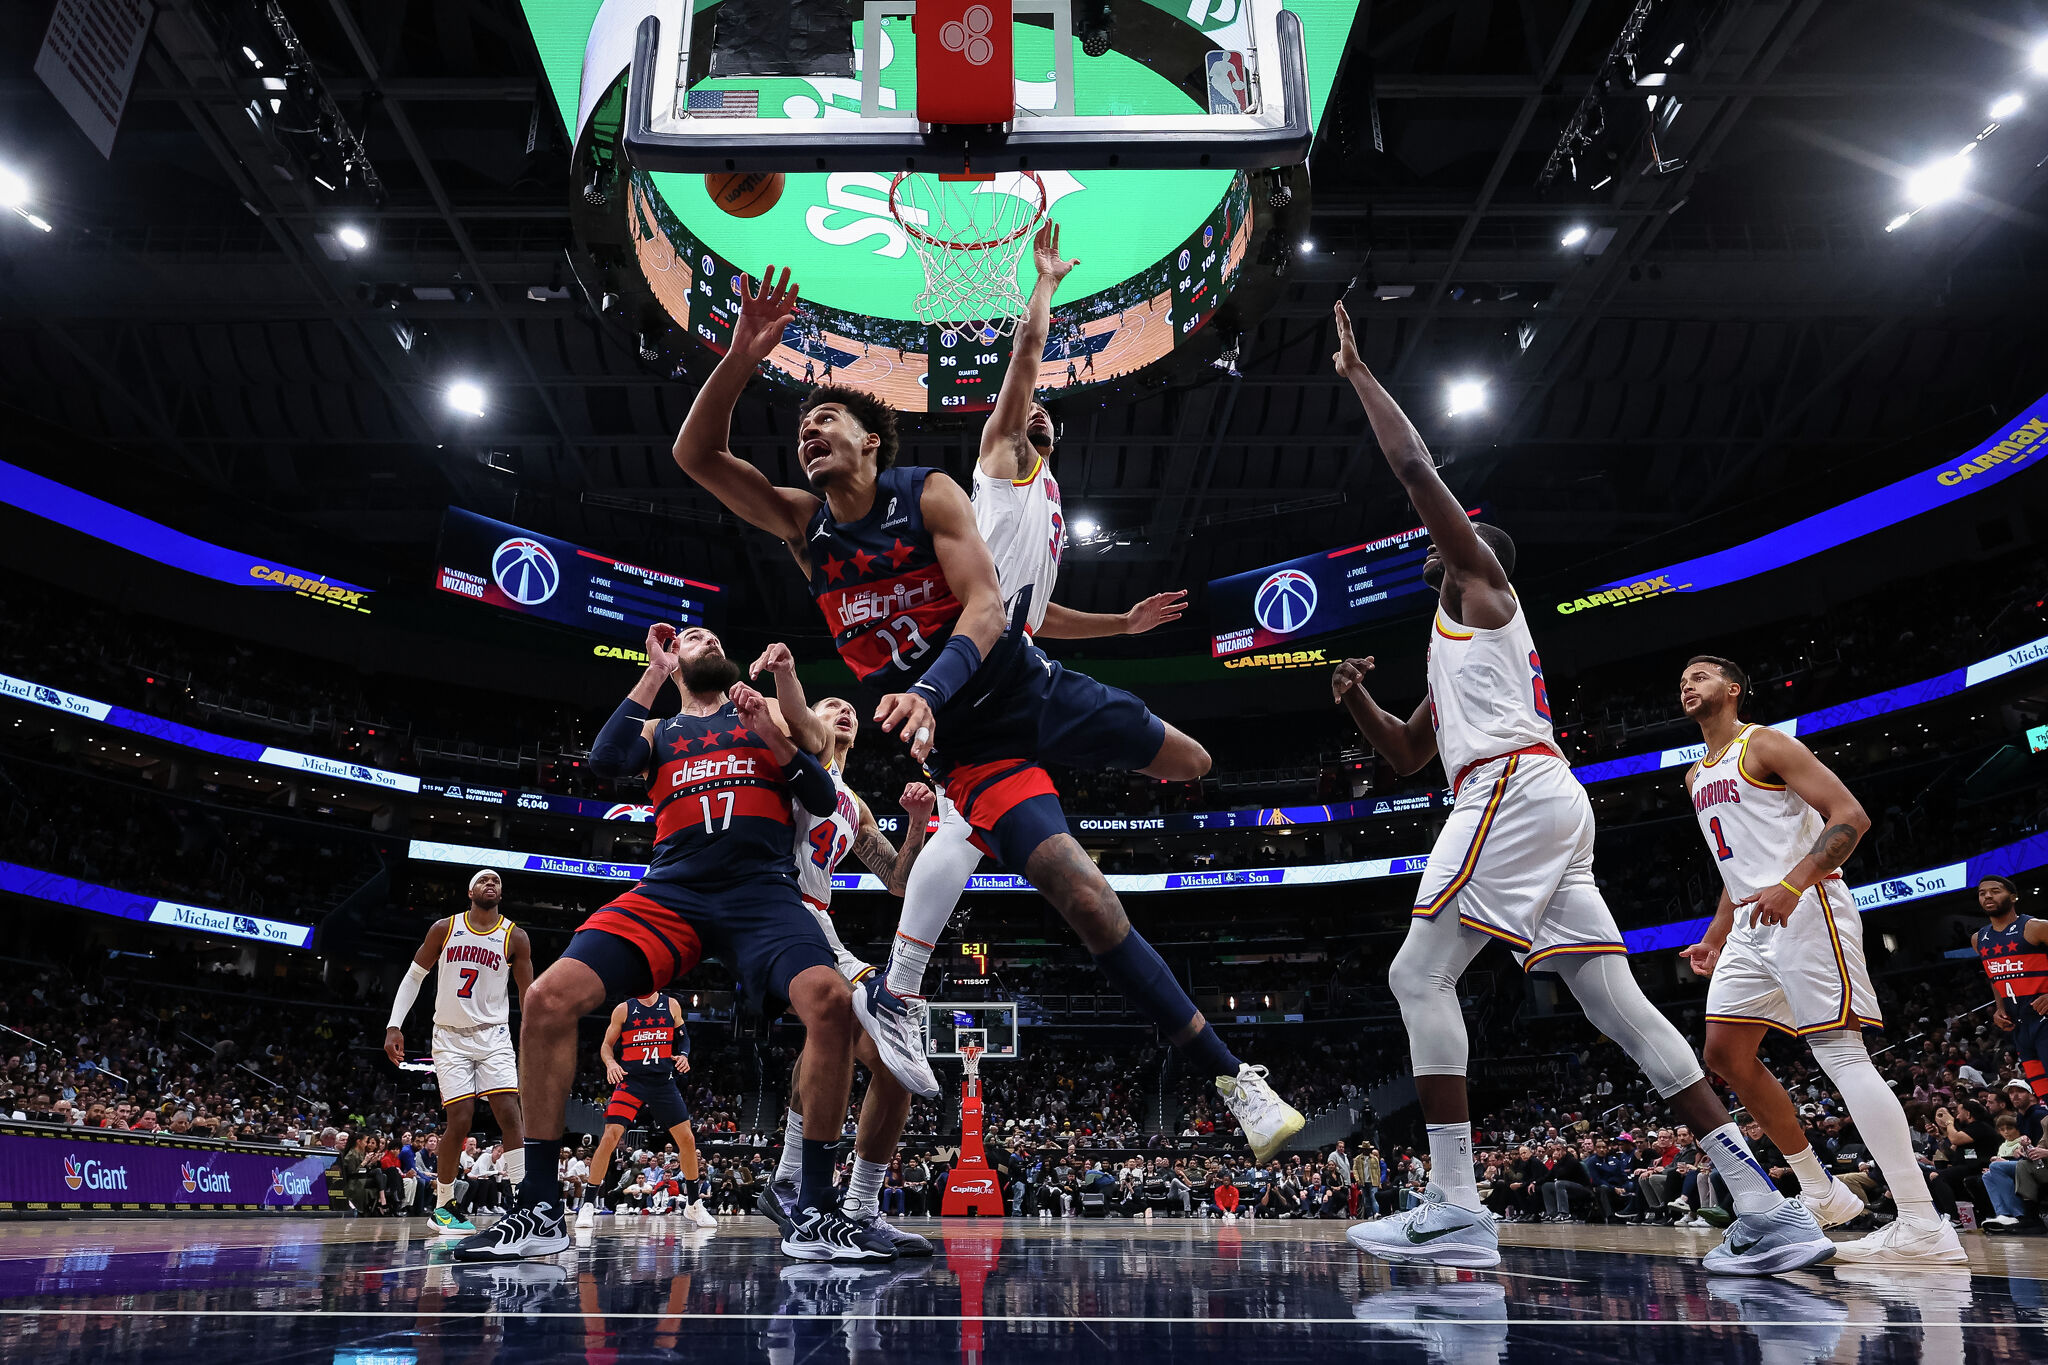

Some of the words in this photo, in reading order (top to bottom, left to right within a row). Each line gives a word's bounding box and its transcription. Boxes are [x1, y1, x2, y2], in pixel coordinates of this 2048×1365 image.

[1201, 250, 1217, 273] 106
[700, 280, 713, 298] 96
[1179, 275, 1192, 293] 96
[1182, 312, 1200, 334] 6:31
[698, 323, 717, 344] 6:31
[940, 356, 957, 367] 96
[974, 353, 999, 366] 106
[942, 396, 966, 406] 6:31
[986, 394, 998, 403] :7
[880, 516, 908, 531] Robinhood
[1366, 536, 1402, 554] SCORING
[1400, 526, 1430, 543] LEAD
[444, 566, 488, 586] WASHINGTON
[614, 562, 649, 579] SCORING
[648, 571, 685, 588] LEADERS
[1352, 566, 1368, 577] POOLE
[250, 566, 364, 605] CARmax
[442, 576, 485, 599] WIZARDS
[1354, 580, 1374, 592] GEORGE
[838, 580, 935, 627] district
[854, 590, 871, 601] THE
[1356, 591, 1388, 606] CARRINGTON
[1556, 576, 1672, 615] CARmax
[876, 616, 931, 672] 13
[1216, 627, 1255, 642] WASHINGTON
[1216, 636, 1254, 655] WIZARDS
[2008, 644, 2048, 668] Micha
[65, 697, 90, 715] Son
[302, 758, 348, 776] Michael
[376, 773, 397, 786] Son
[672, 754, 756, 787] district
[694, 758, 708, 767] THE
[466, 788, 503, 798] FOUNDATION
[483, 796, 503, 804] RAFFLE
[1393, 796, 1429, 805] FOUNDATION
[517, 798, 549, 810] $6,040
[700, 792, 735, 835] 17
[1411, 802, 1430, 810] RAFFLE
[878, 818, 898, 831] 96
[1080, 819, 1128, 830] GOLDEN
[1130, 819, 1165, 830] STATE
[1199, 820, 1204, 829] 3
[1230, 818, 1235, 827] 3
[1710, 816, 1734, 862] 1
[540, 858, 583, 874] Michael
[609, 866, 631, 877] Son
[830, 877, 846, 887] on
[972, 877, 1013, 888] Michael
[1016, 877, 1025, 885] &
[1180, 875, 1222, 886] Michael
[1249, 873, 1270, 883] Son
[1852, 888, 1881, 908] hael
[1884, 882, 1897, 895] &
[1915, 877, 1946, 893] Son
[173, 908, 230, 930] Michael
[263, 924, 288, 940] Son
[962, 943, 988, 955] 6:31
[446, 946, 502, 972] WARRIORS
[972, 955, 985, 975] 7
[457, 968, 479, 999] 7
[2005, 982, 2018, 1005] 4
[633, 1030, 668, 1042] district
[642, 1047, 660, 1066] 24
[84, 1160, 128, 1191] Giant
[197, 1166, 232, 1193] Giant
[284, 1172, 312, 1195] Giant
